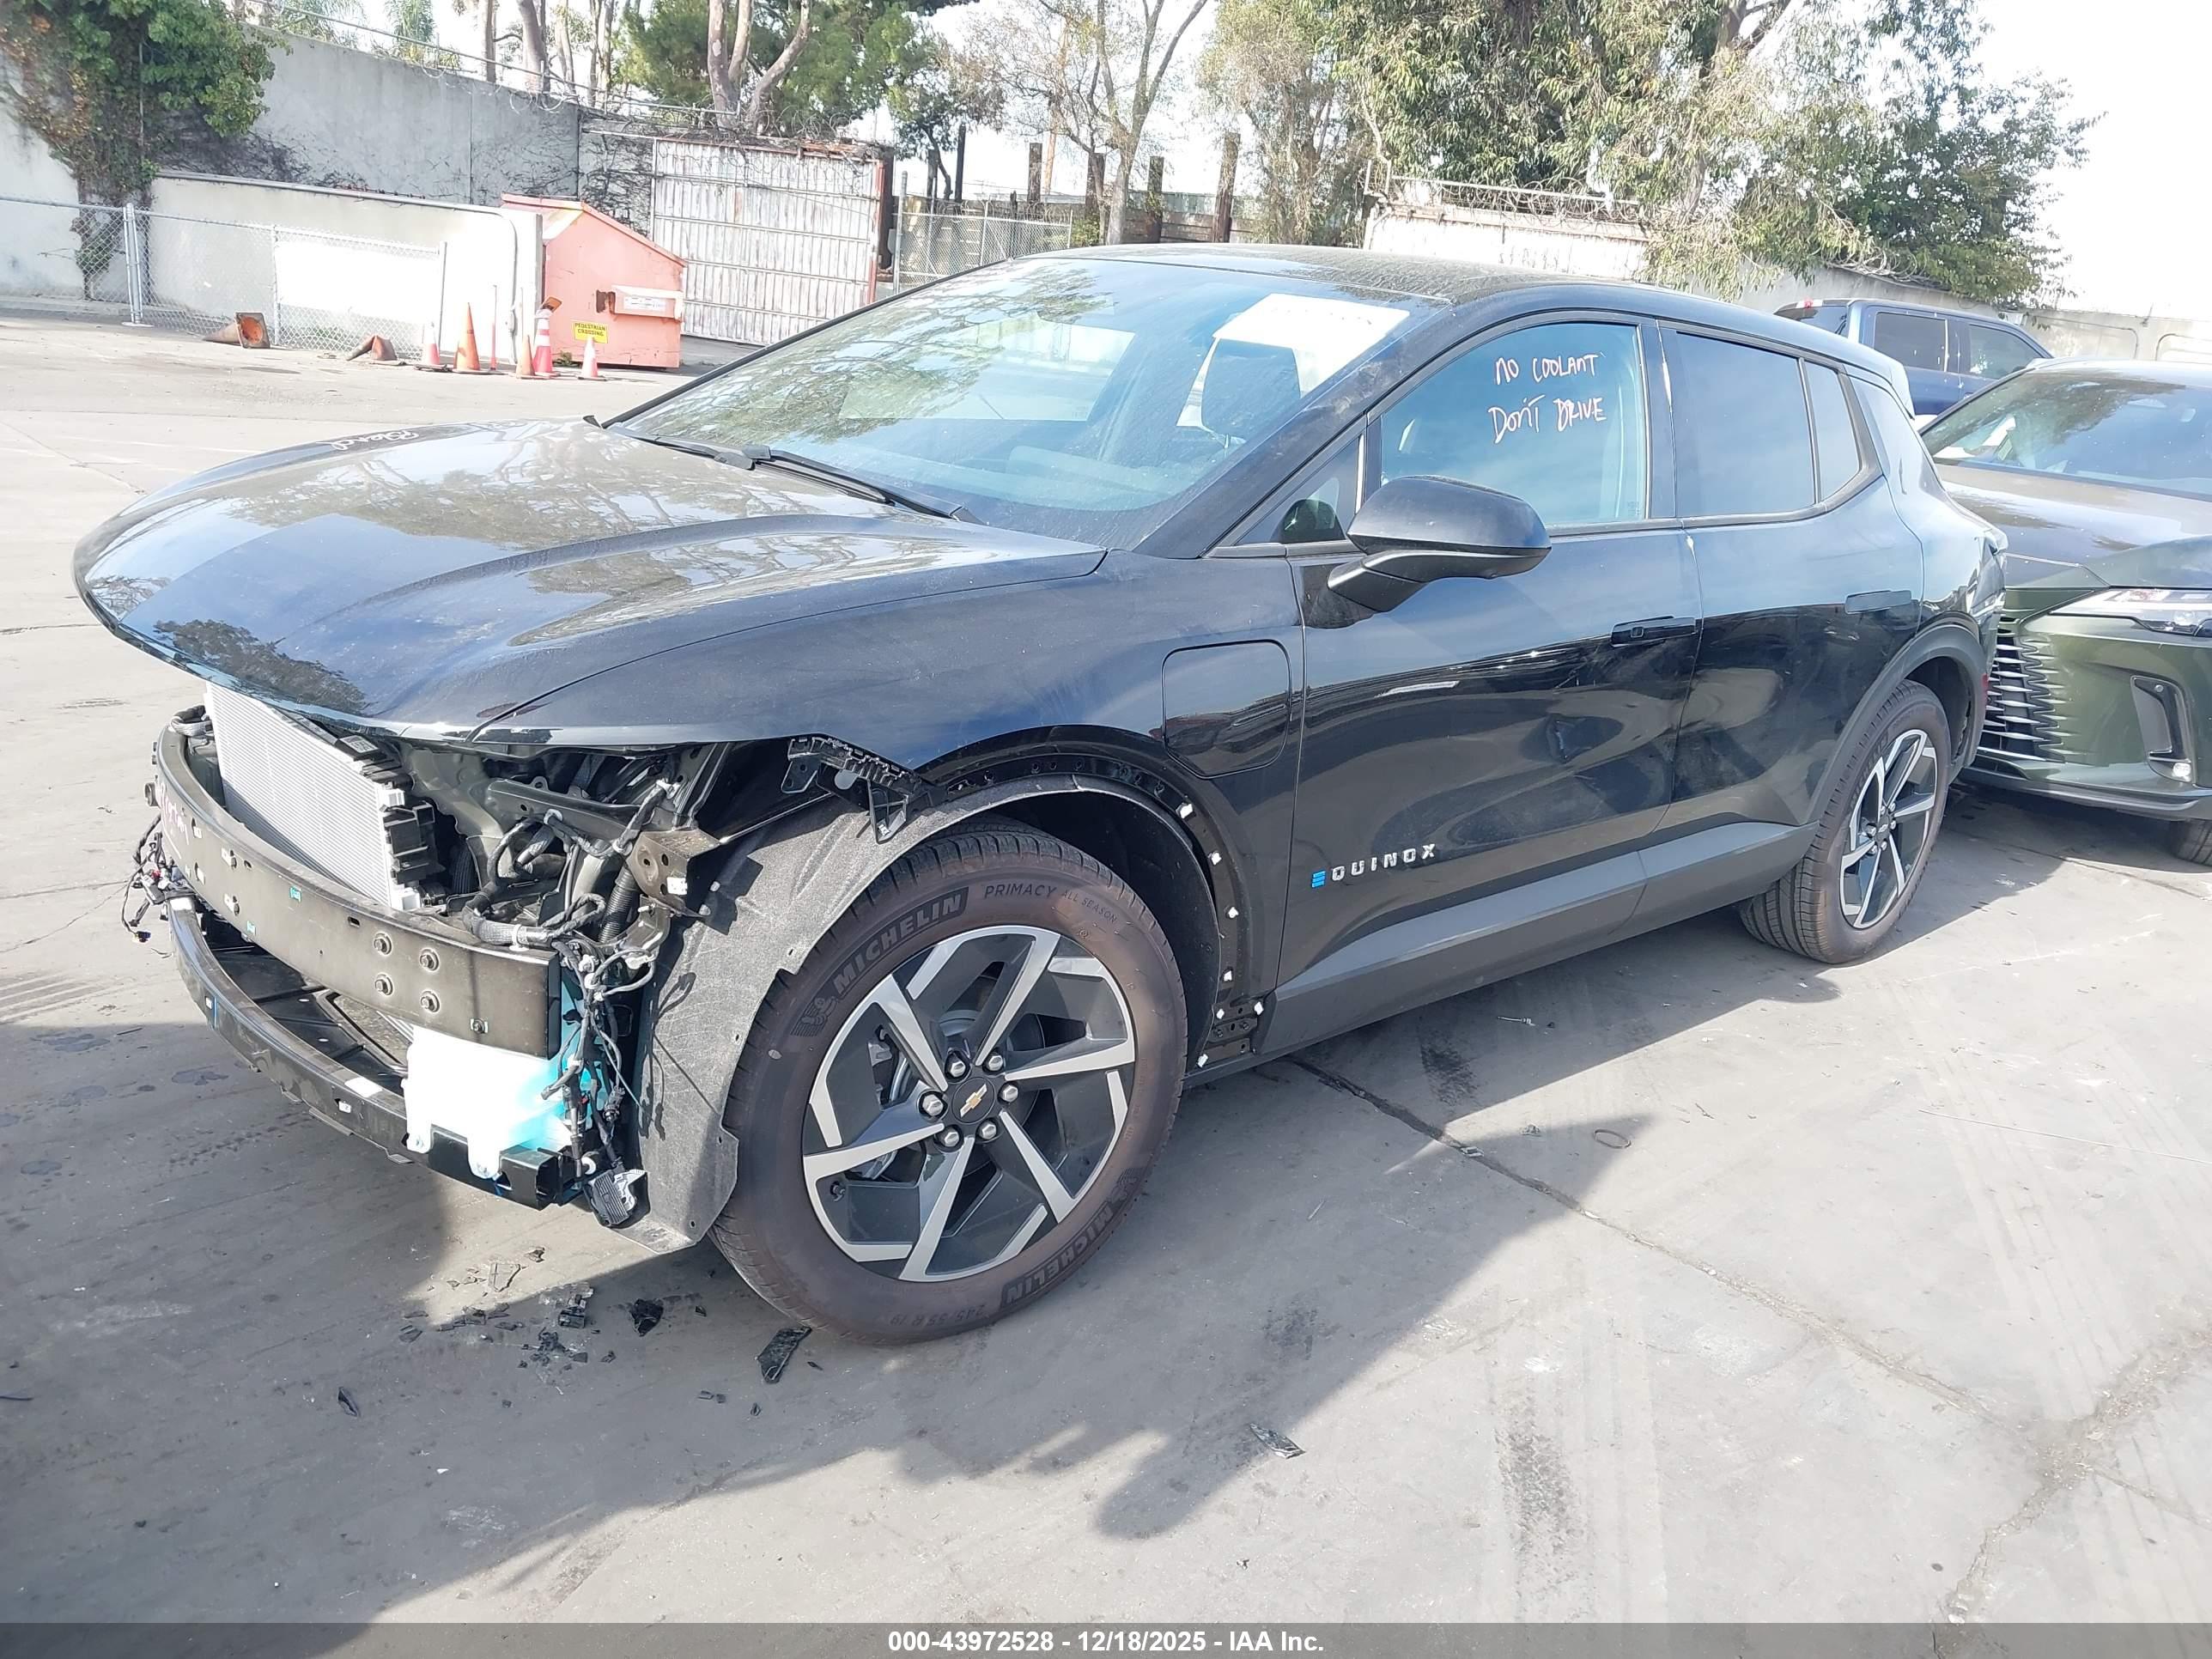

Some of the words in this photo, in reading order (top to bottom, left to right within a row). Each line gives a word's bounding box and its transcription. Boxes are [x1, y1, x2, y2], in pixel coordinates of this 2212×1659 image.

[574, 322, 606, 331] PEDESTRIAN
[577, 328, 605, 337] CROSSING
[1496, 357, 1520, 386] NO
[1532, 354, 1599, 383] COOLANT
[1553, 398, 1607, 432] DRIVE
[1311, 843, 1436, 888] EQUINOX
[984, 883, 1057, 898] PRIMACY
[1062, 890, 1079, 902] ALL
[1082, 898, 1117, 924] SEASON
[833, 895, 961, 995] MICHELIN
[1006, 1205, 1114, 1304] MICHELIN
